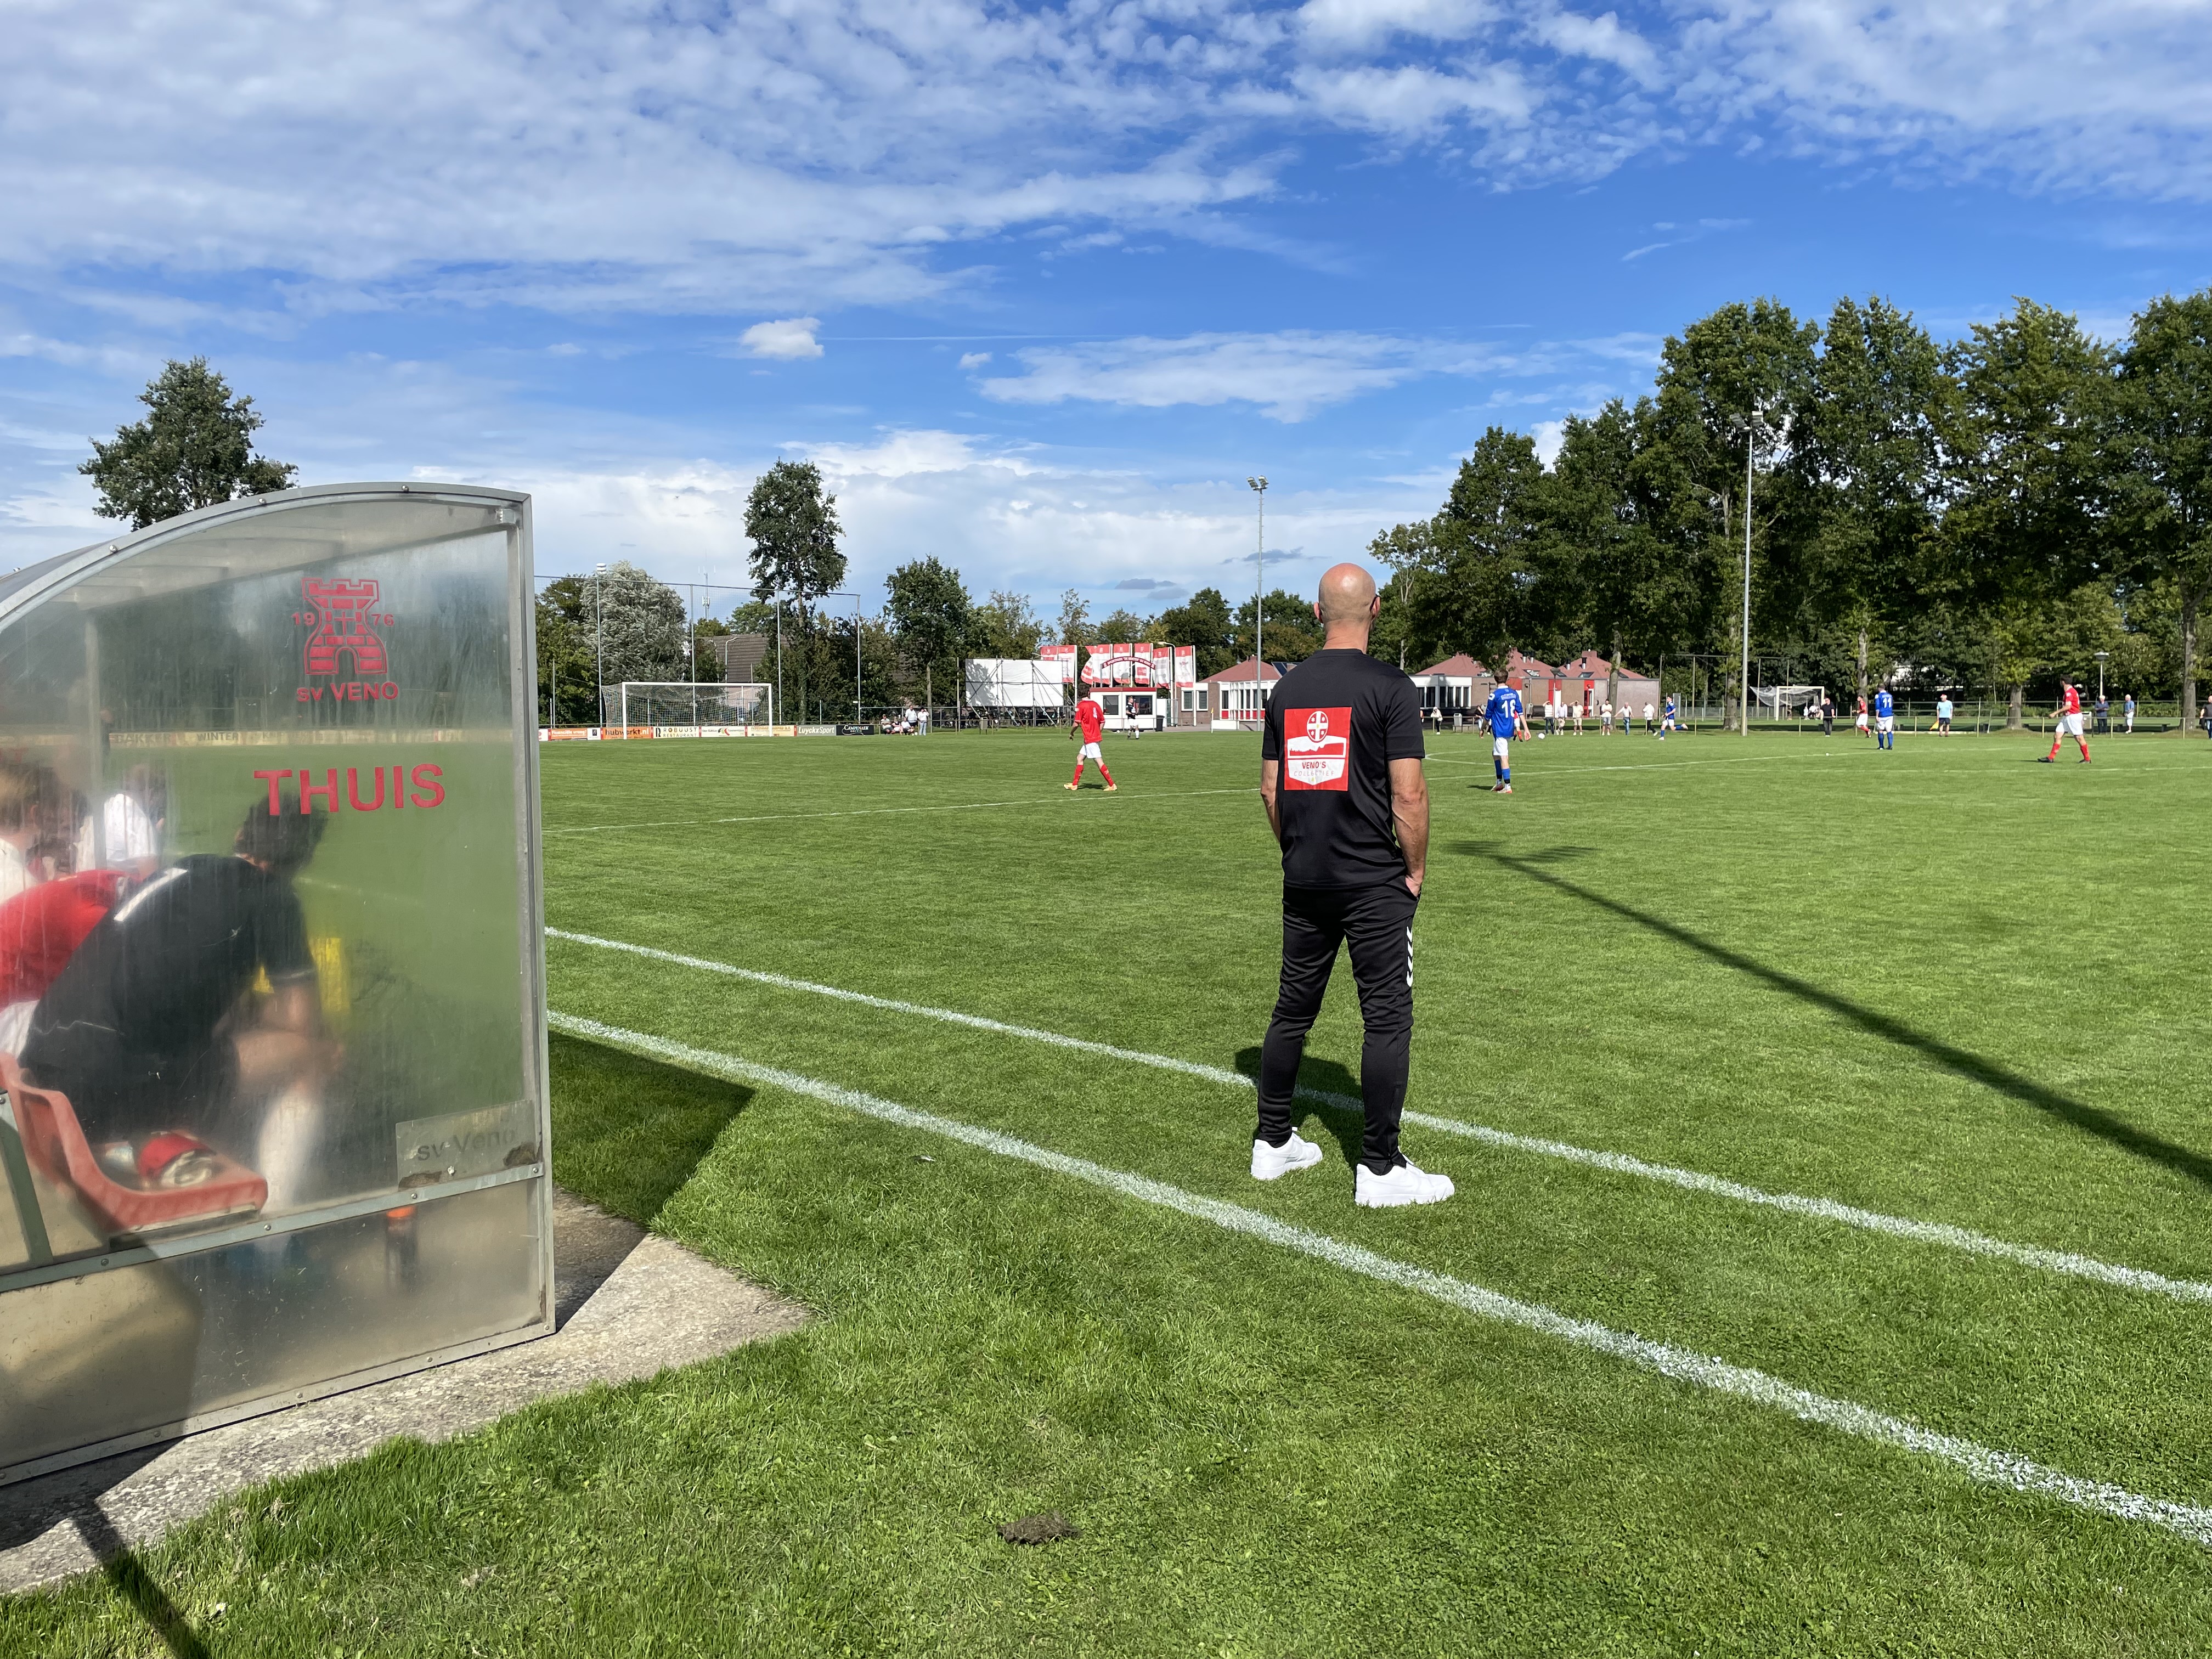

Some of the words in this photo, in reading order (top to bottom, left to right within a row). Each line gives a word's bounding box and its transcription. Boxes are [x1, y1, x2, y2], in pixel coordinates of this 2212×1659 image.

[291, 612, 315, 626] 19
[371, 613, 394, 627] 76
[297, 687, 323, 702] sv
[330, 681, 399, 701] VENO
[1502, 699, 1516, 718] 18
[1883, 697, 1892, 708] 11
[196, 732, 238, 741] WINTER
[798, 726, 835, 735] LuyckxSport
[1302, 761, 1327, 769] VENO'S
[253, 763, 445, 815] THUIS
